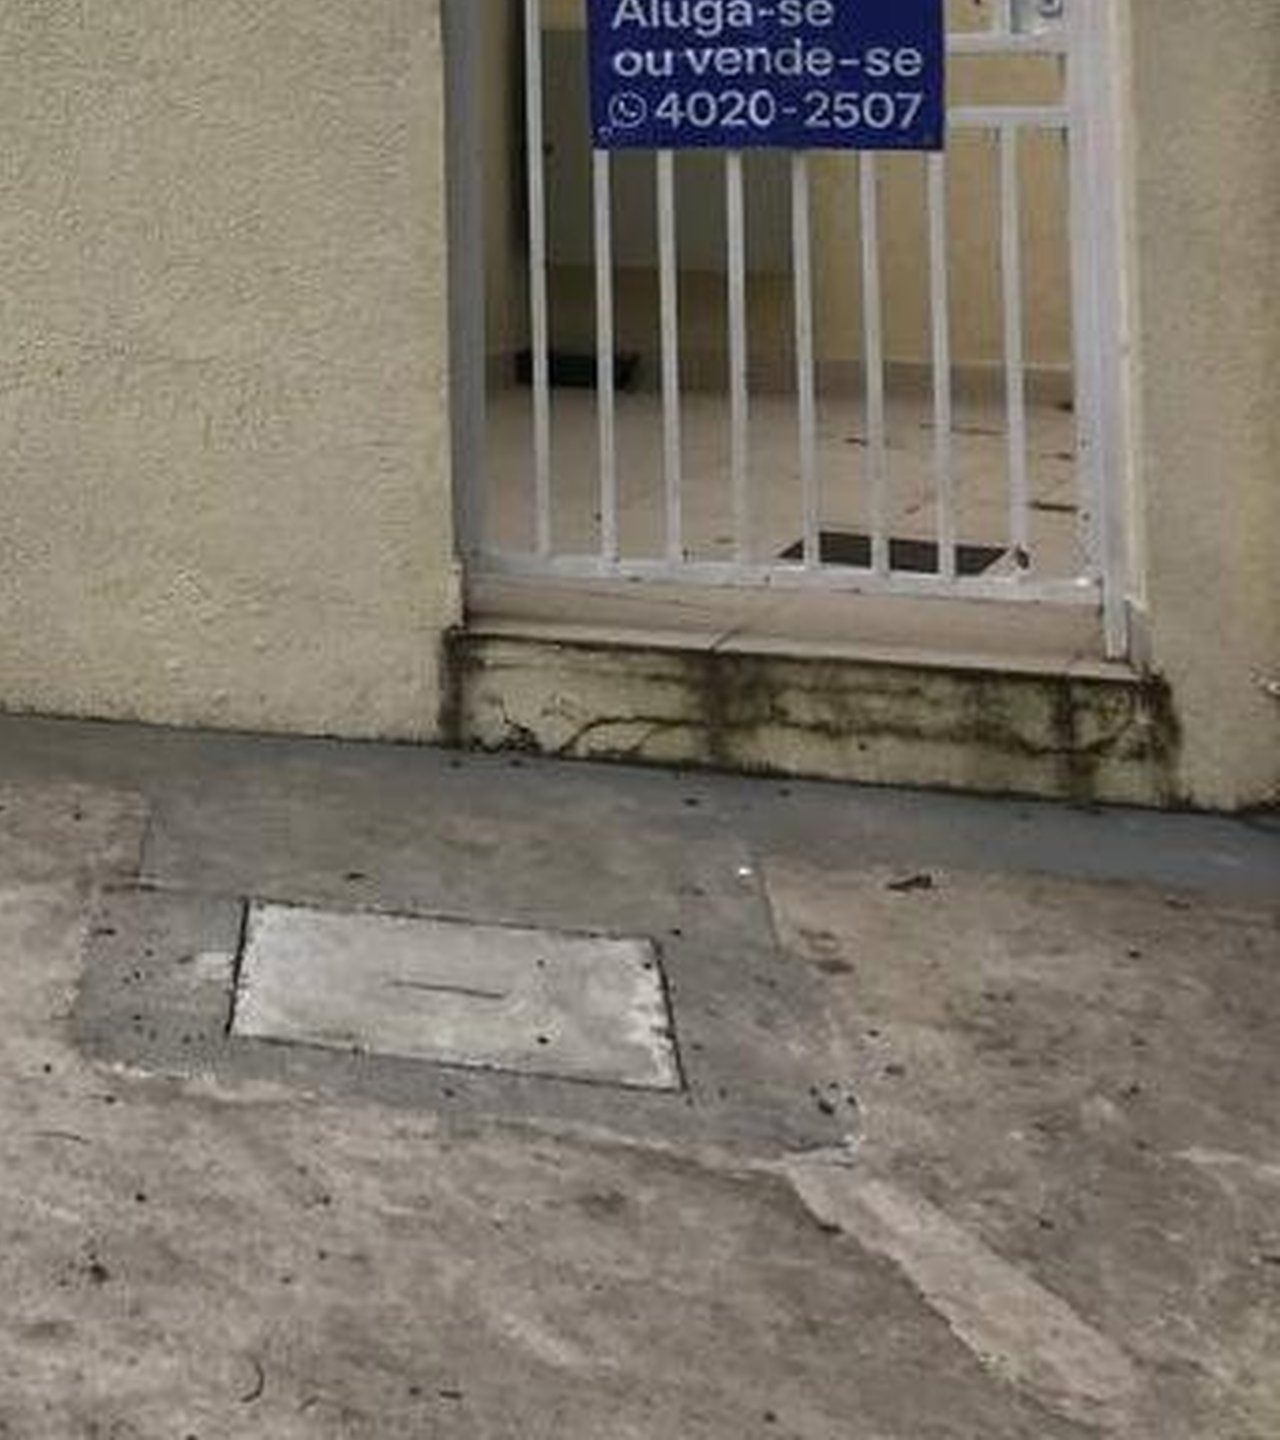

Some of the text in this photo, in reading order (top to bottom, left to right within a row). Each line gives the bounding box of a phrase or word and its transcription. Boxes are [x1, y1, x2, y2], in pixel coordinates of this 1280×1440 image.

[613, 38, 924, 78] ou vende-se
[655, 90, 924, 130] 4020-2507
